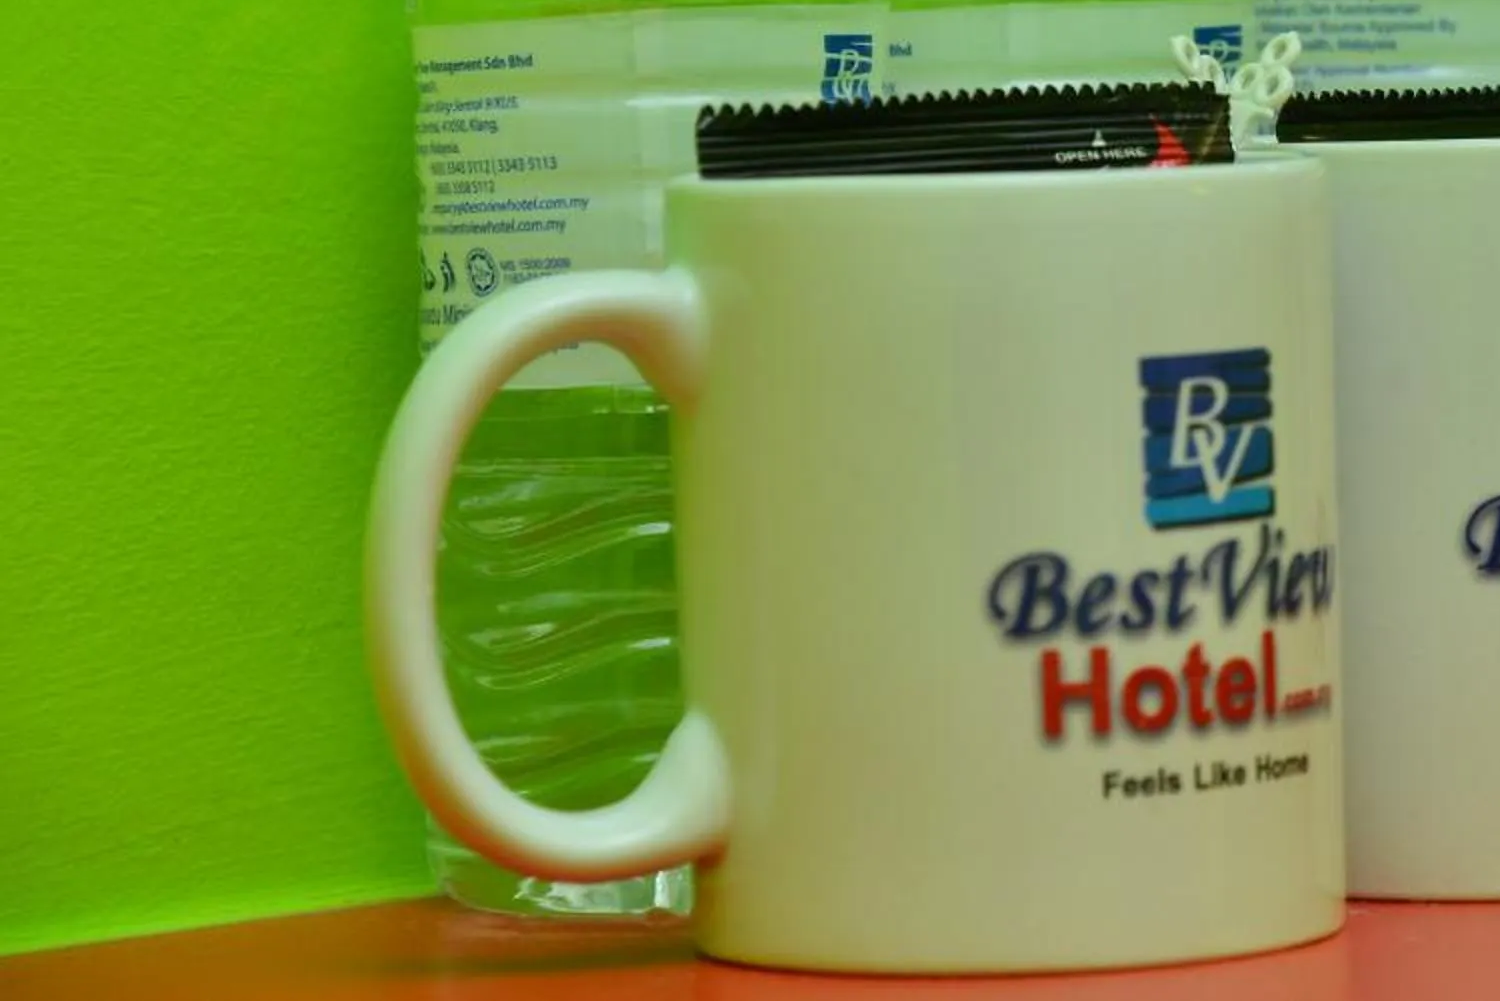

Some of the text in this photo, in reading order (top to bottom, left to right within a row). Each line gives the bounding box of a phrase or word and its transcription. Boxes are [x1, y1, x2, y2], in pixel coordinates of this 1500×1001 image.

[1055, 146, 1149, 164] OPEN HERE
[1103, 752, 1309, 798] Feels Like Home
